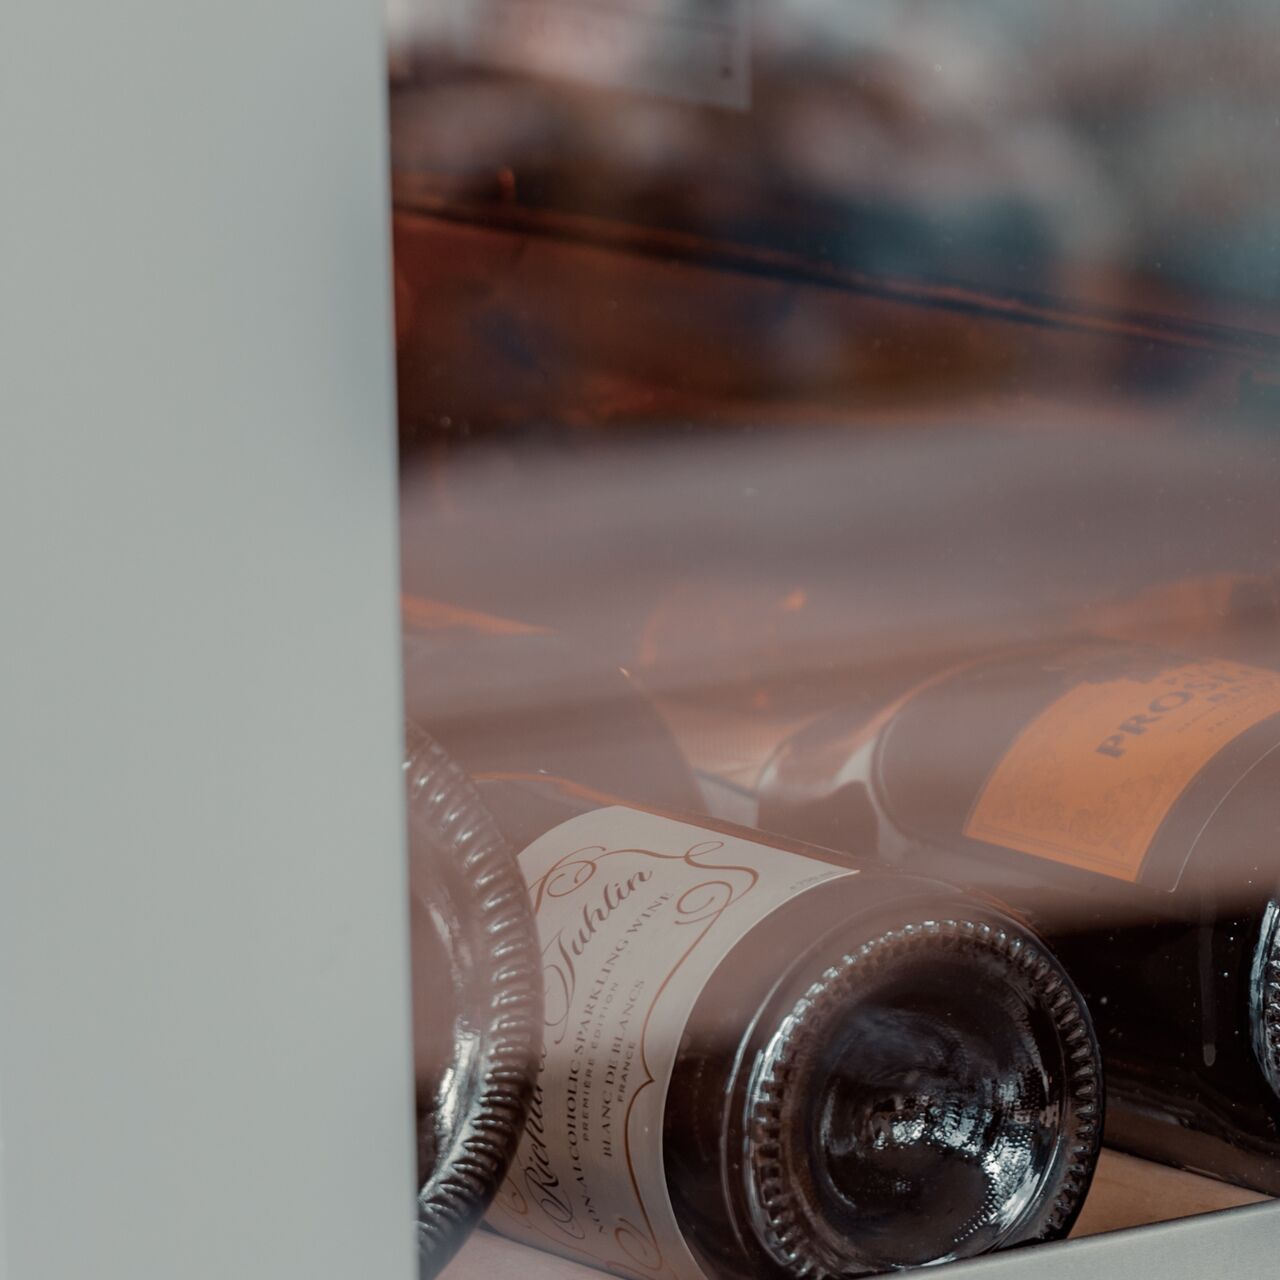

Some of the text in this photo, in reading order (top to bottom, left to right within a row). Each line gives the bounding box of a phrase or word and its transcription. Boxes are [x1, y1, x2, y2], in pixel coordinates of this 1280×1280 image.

[574, 939, 629, 1056] SPARKLING
[626, 891, 674, 934] WINE
[601, 979, 645, 1157] BLANC DE BLANCS
[617, 1041, 636, 1103] FRANCE
